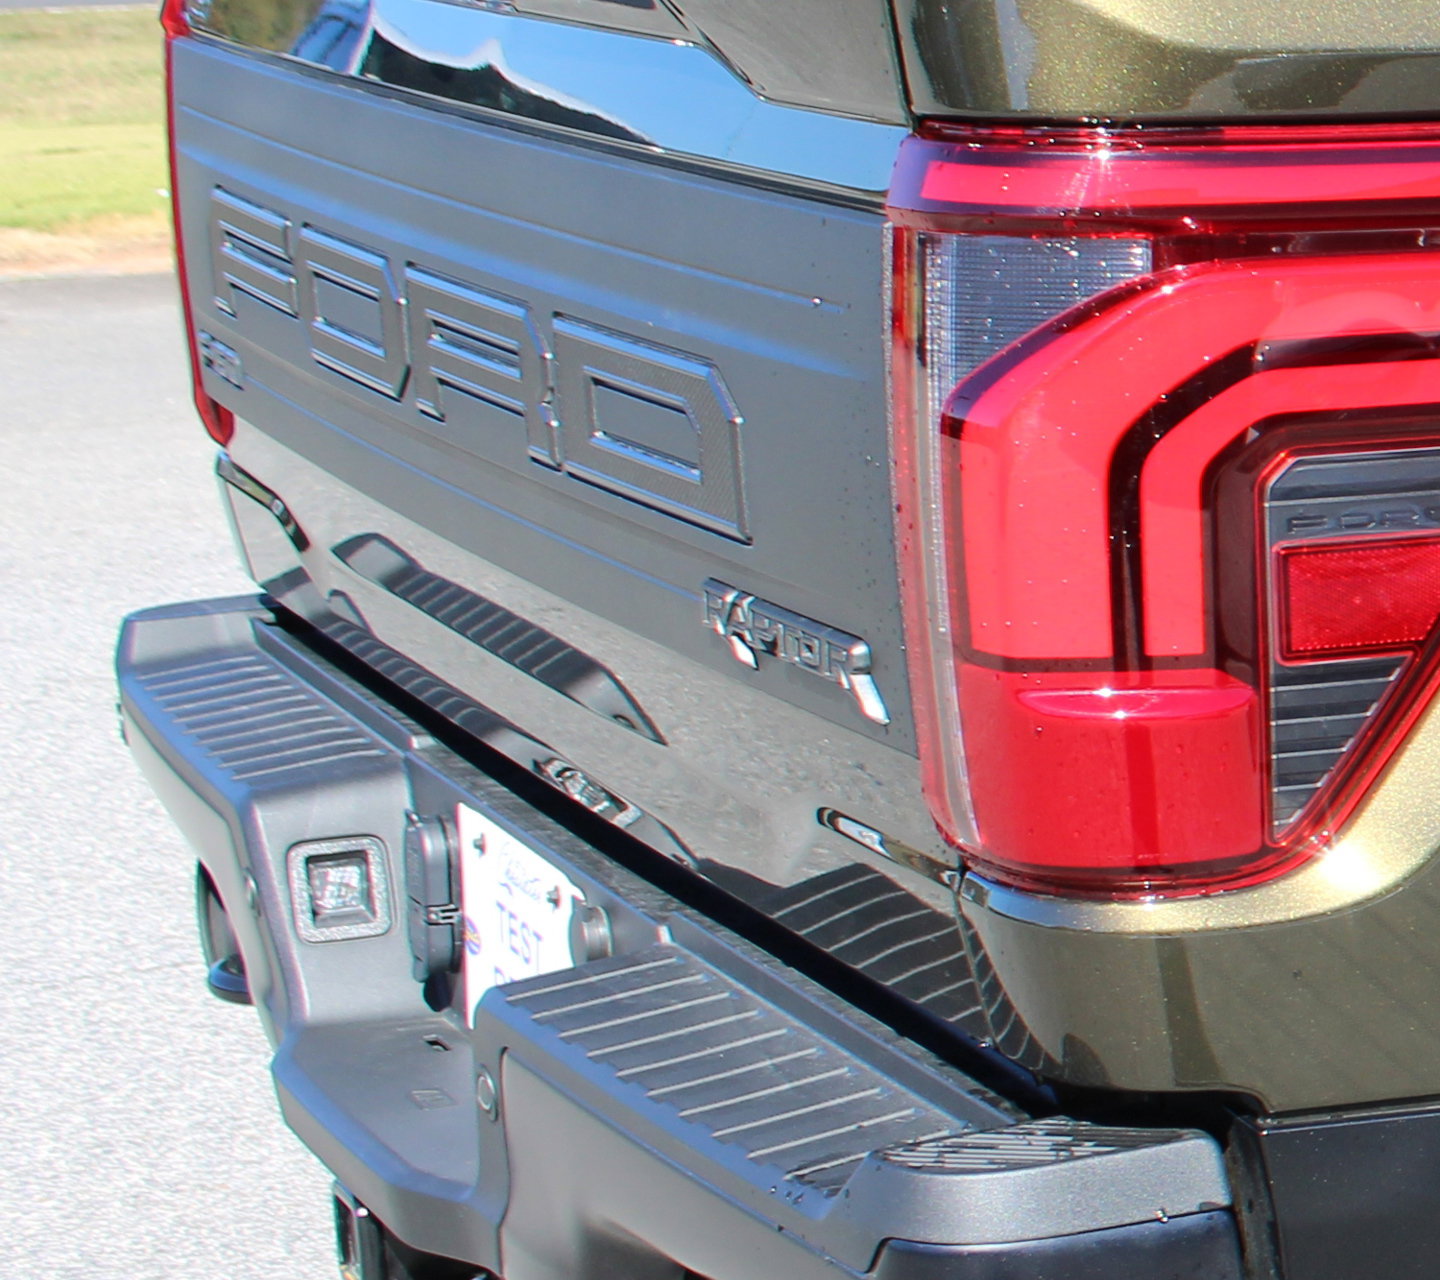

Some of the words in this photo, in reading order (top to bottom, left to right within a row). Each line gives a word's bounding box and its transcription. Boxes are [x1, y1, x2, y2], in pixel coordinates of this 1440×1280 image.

[210, 184, 753, 546] FORD
[702, 577, 890, 726] RAPTOR
[496, 901, 543, 974] TEST
